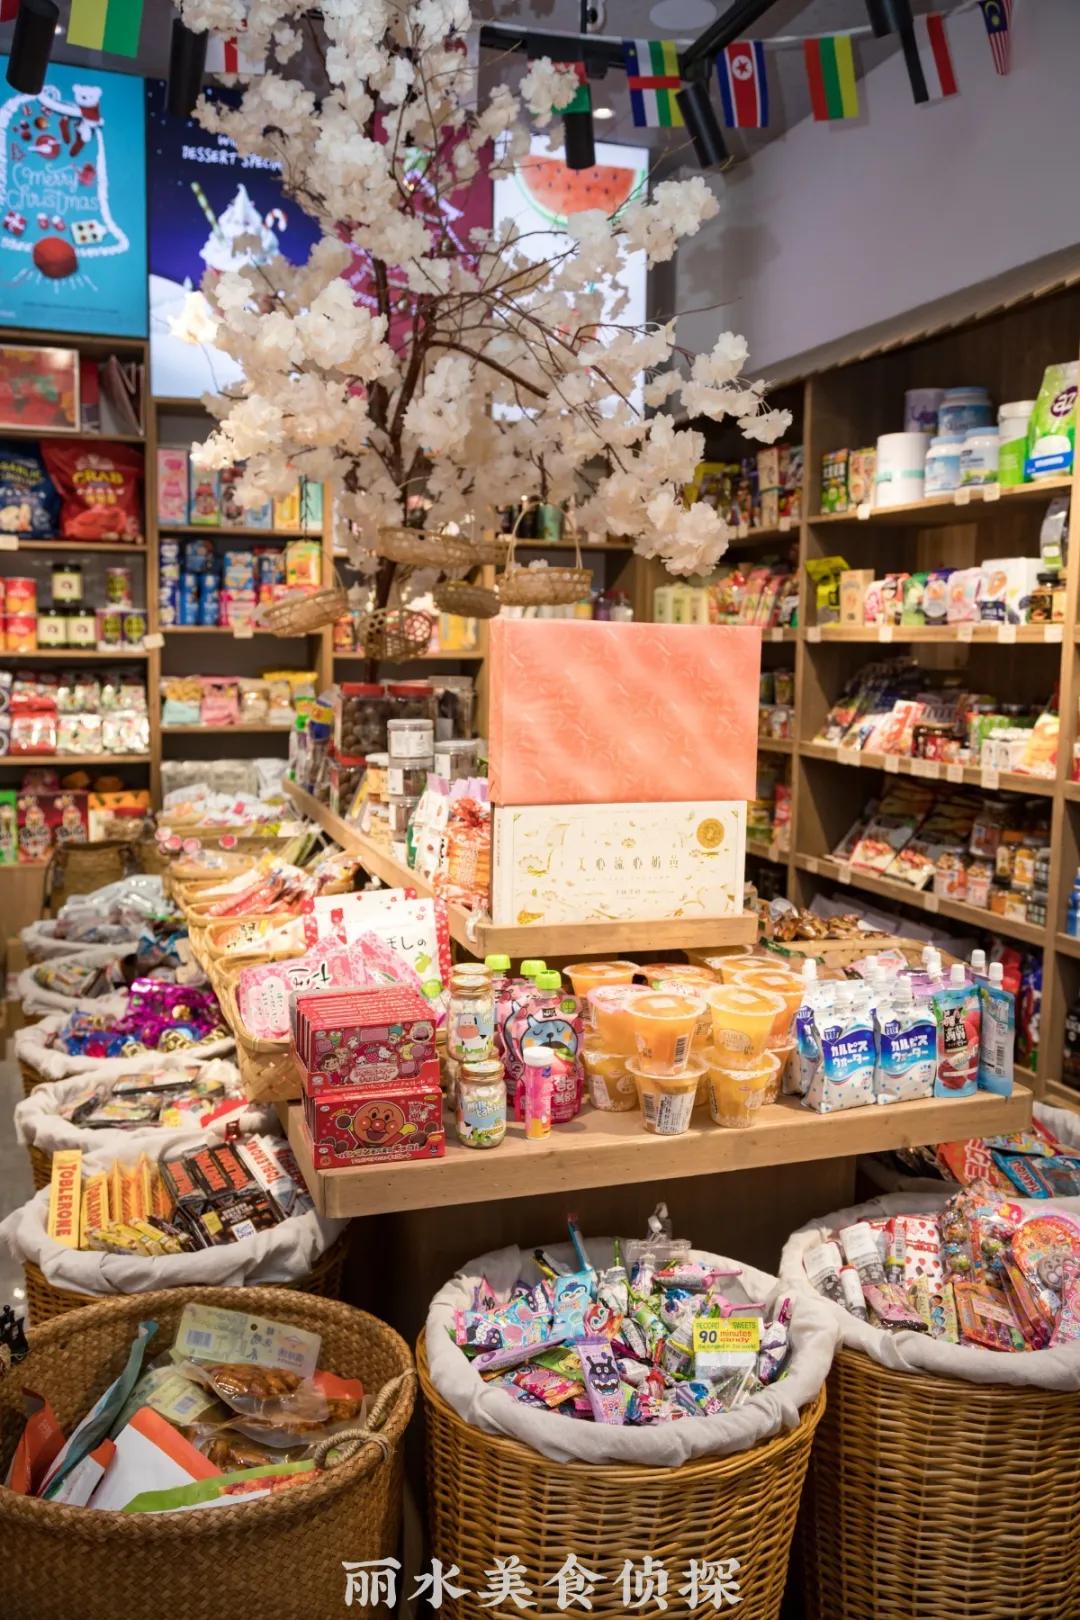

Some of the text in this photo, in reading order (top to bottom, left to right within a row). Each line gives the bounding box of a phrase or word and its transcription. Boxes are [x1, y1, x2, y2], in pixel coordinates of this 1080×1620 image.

[182, 145, 238, 165] DESSERT
[7, 185, 98, 215] Christmas
[831, 1040, 868, 1057] カルピス
[891, 1034, 929, 1052] カルピス
[56, 1164, 77, 1237] TOBLERONE
[732, 1321, 757, 1329] SWEETS
[699, 1330, 717, 1343] 90
